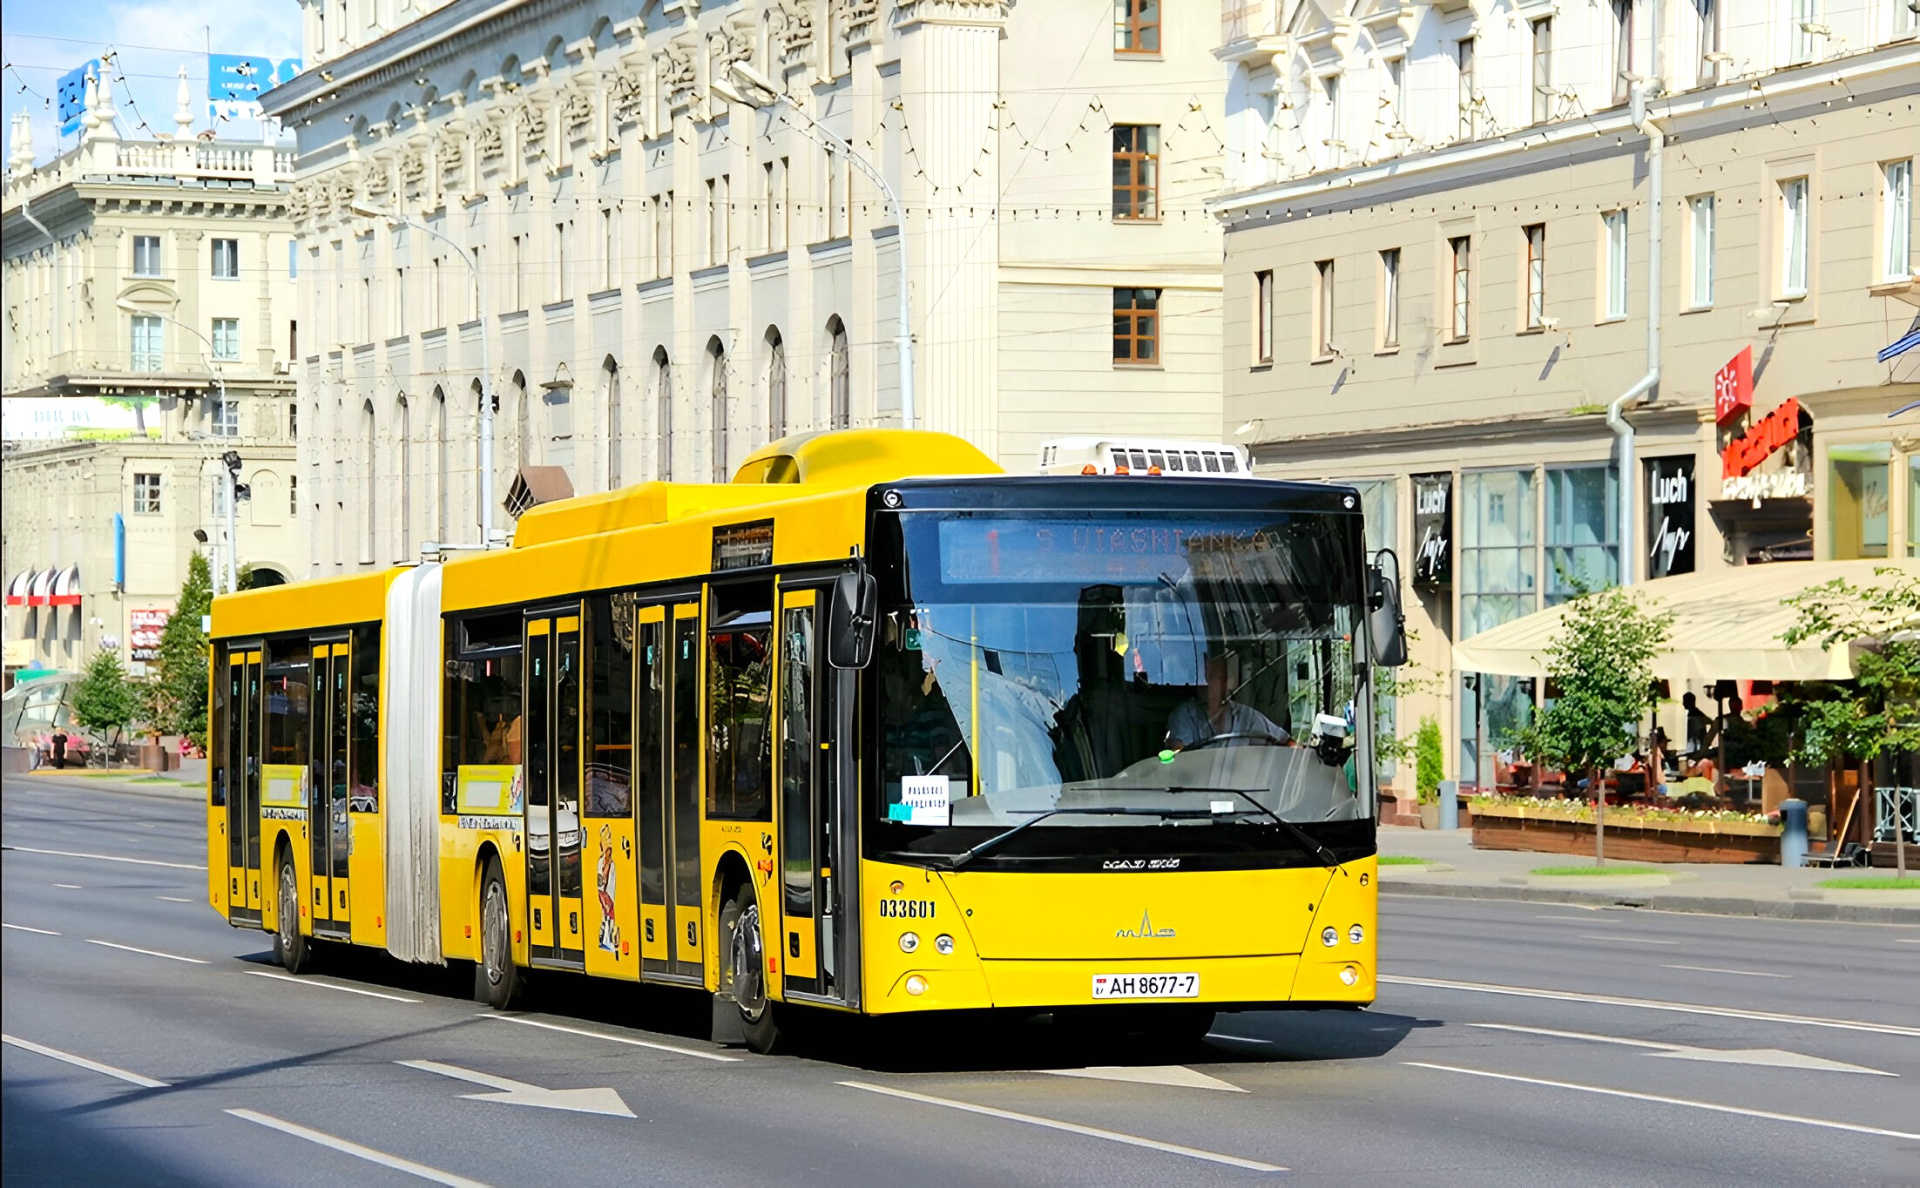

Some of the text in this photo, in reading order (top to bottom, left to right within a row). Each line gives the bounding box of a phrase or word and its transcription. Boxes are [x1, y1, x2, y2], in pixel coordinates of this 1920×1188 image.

[1652, 468, 1687, 504] Luch
[986, 530, 999, 577] 1
[880, 899, 935, 918] 033601
[1110, 977, 1135, 995] AH
[1139, 976, 1195, 994] 8677-7
